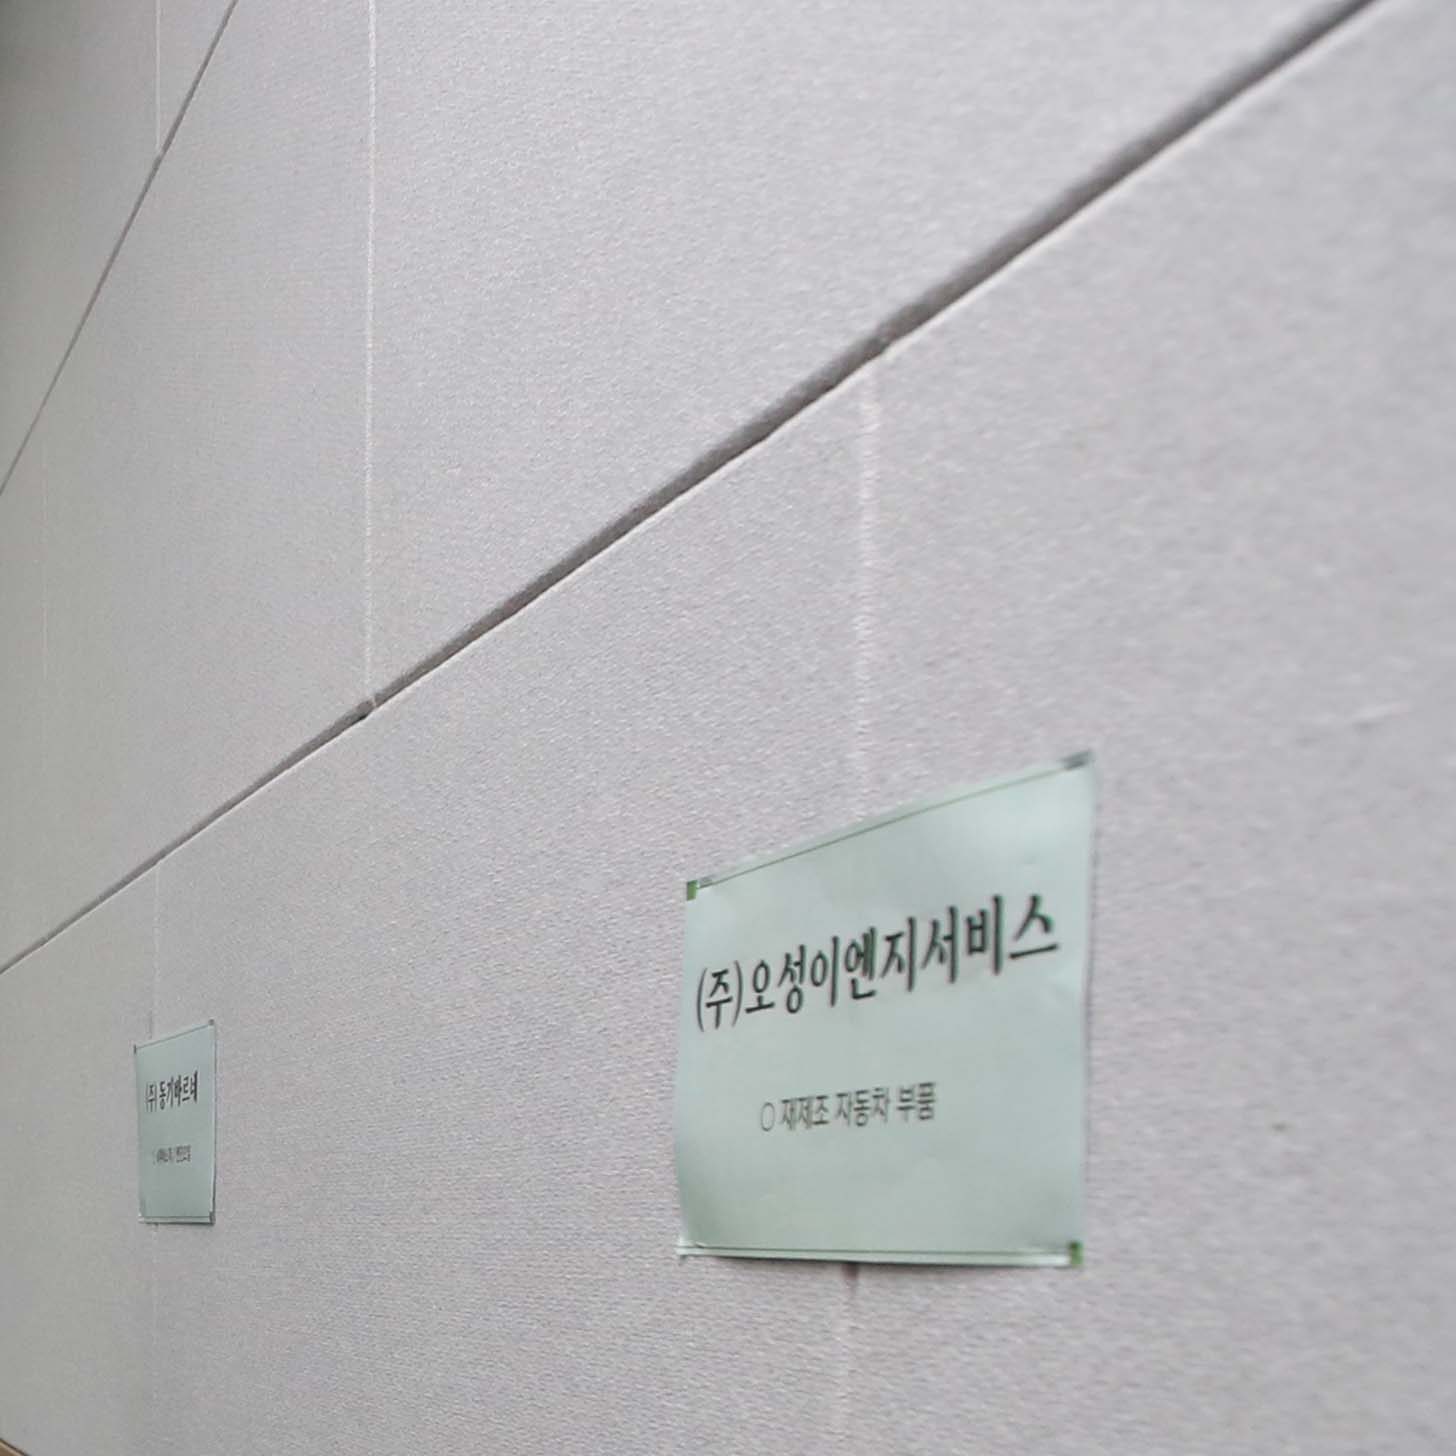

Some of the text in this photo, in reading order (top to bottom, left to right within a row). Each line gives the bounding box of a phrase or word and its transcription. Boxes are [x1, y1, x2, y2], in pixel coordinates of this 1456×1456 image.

[696, 893, 1059, 1032] (주)오성이엔지서비스
[834, 1087, 890, 1127] 자동차
[895, 1081, 937, 1122] 부품
